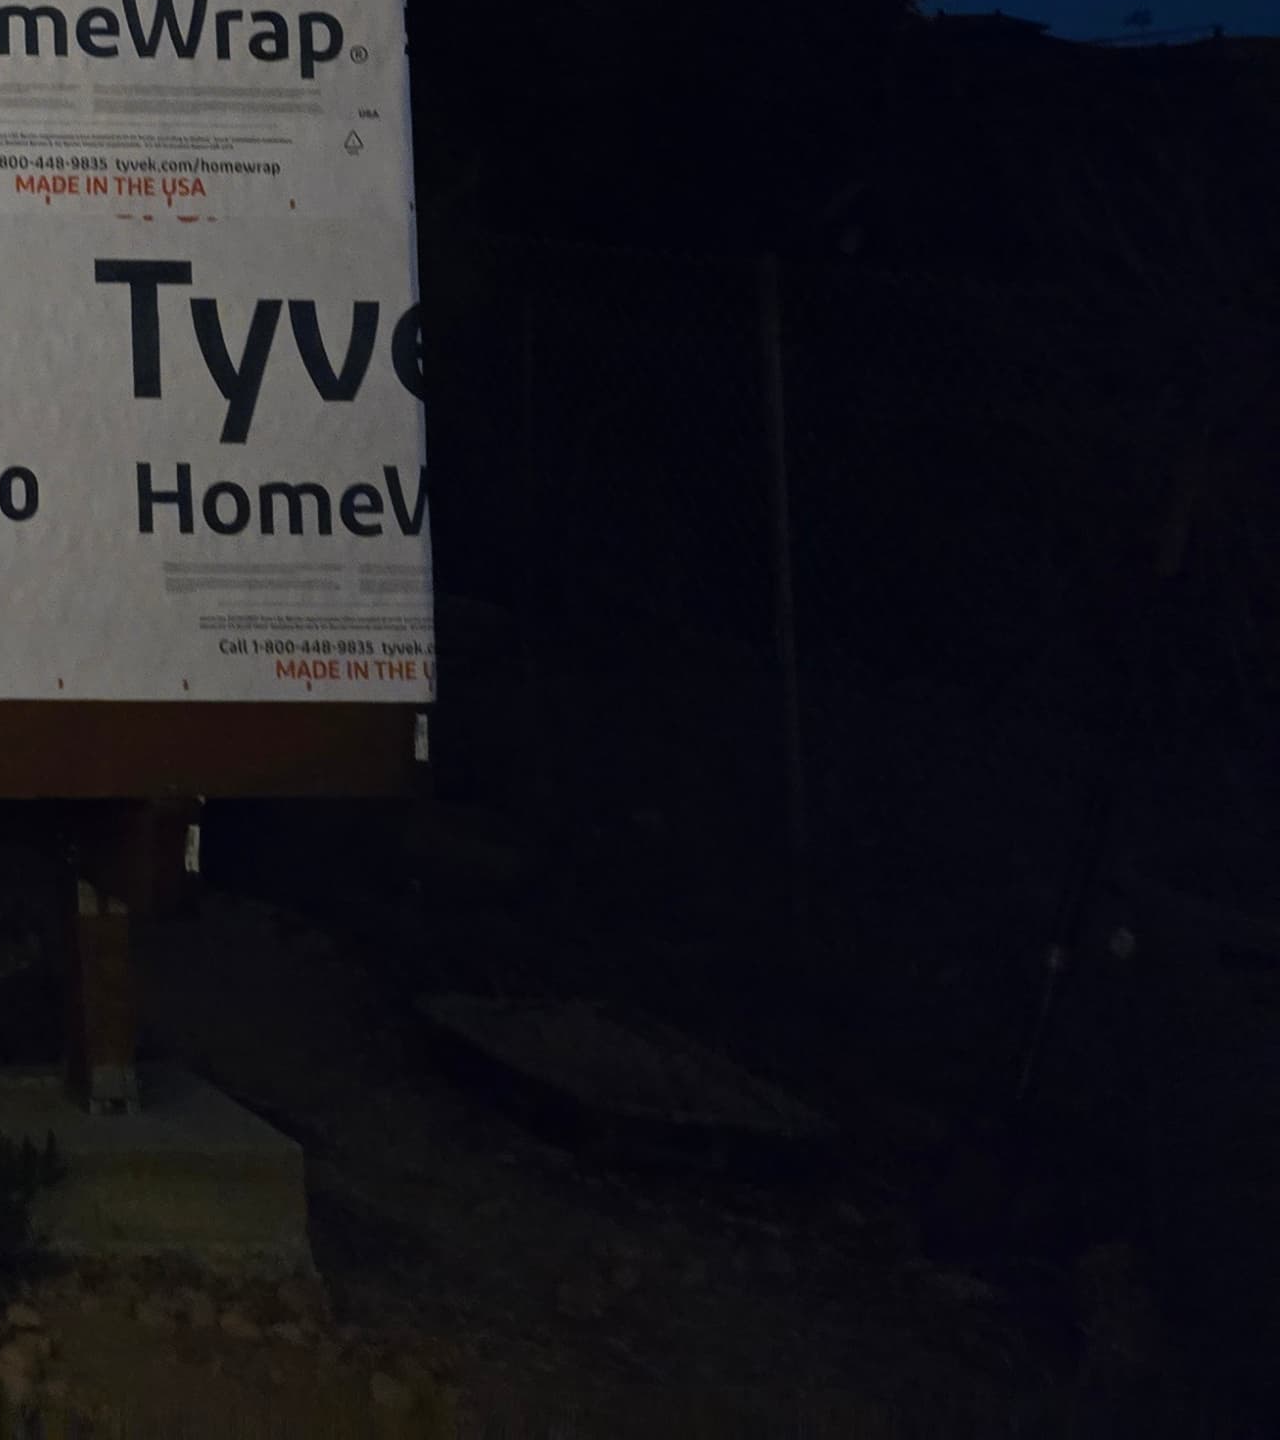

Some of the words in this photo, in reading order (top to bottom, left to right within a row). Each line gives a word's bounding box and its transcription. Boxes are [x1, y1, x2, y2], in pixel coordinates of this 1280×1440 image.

[115, 157, 281, 177] tyvek.com/homewrap
[16, 174, 80, 195] MADE
[86, 175, 108, 195] IN
[113, 176, 155, 196] THE
[162, 177, 206, 197] USA
[219, 638, 248, 655] Call
[252, 639, 374, 655] 1-800-448-9835
[275, 658, 340, 680] MADE
[347, 659, 369, 680] IN
[374, 660, 417, 680] THE
